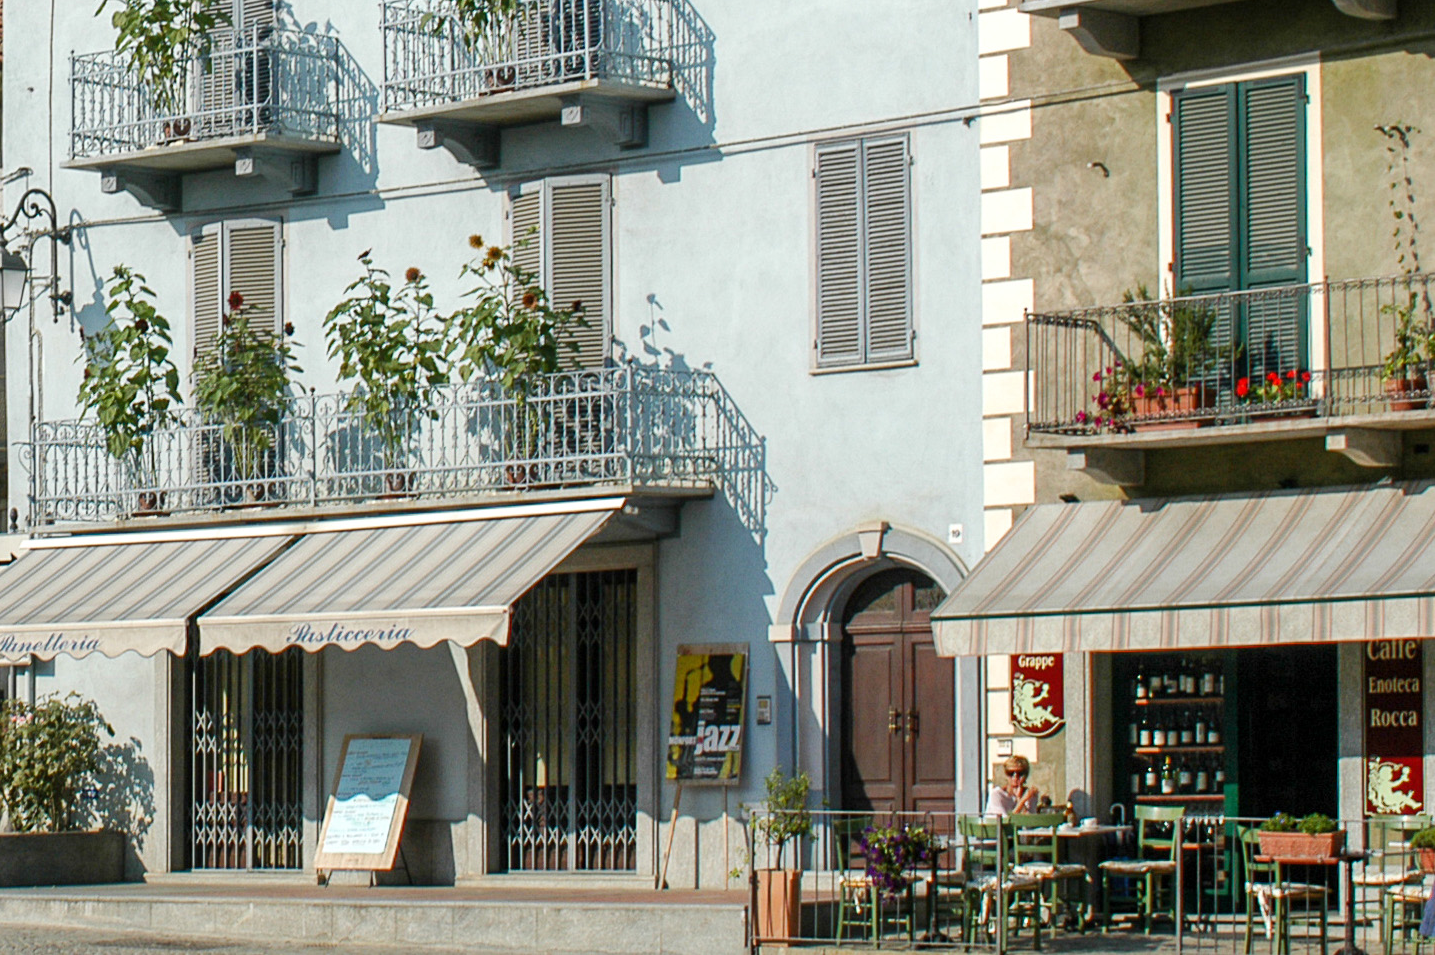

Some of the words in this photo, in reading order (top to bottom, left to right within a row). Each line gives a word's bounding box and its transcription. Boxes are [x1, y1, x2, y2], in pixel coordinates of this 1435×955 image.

[286, 622, 416, 643] Pasticceria
[1018, 654, 1055, 670] Grappe
[1368, 676, 1421, 694] Enoteca
[1370, 708, 1419, 727] Rocca
[694, 720, 741, 756] jazz
